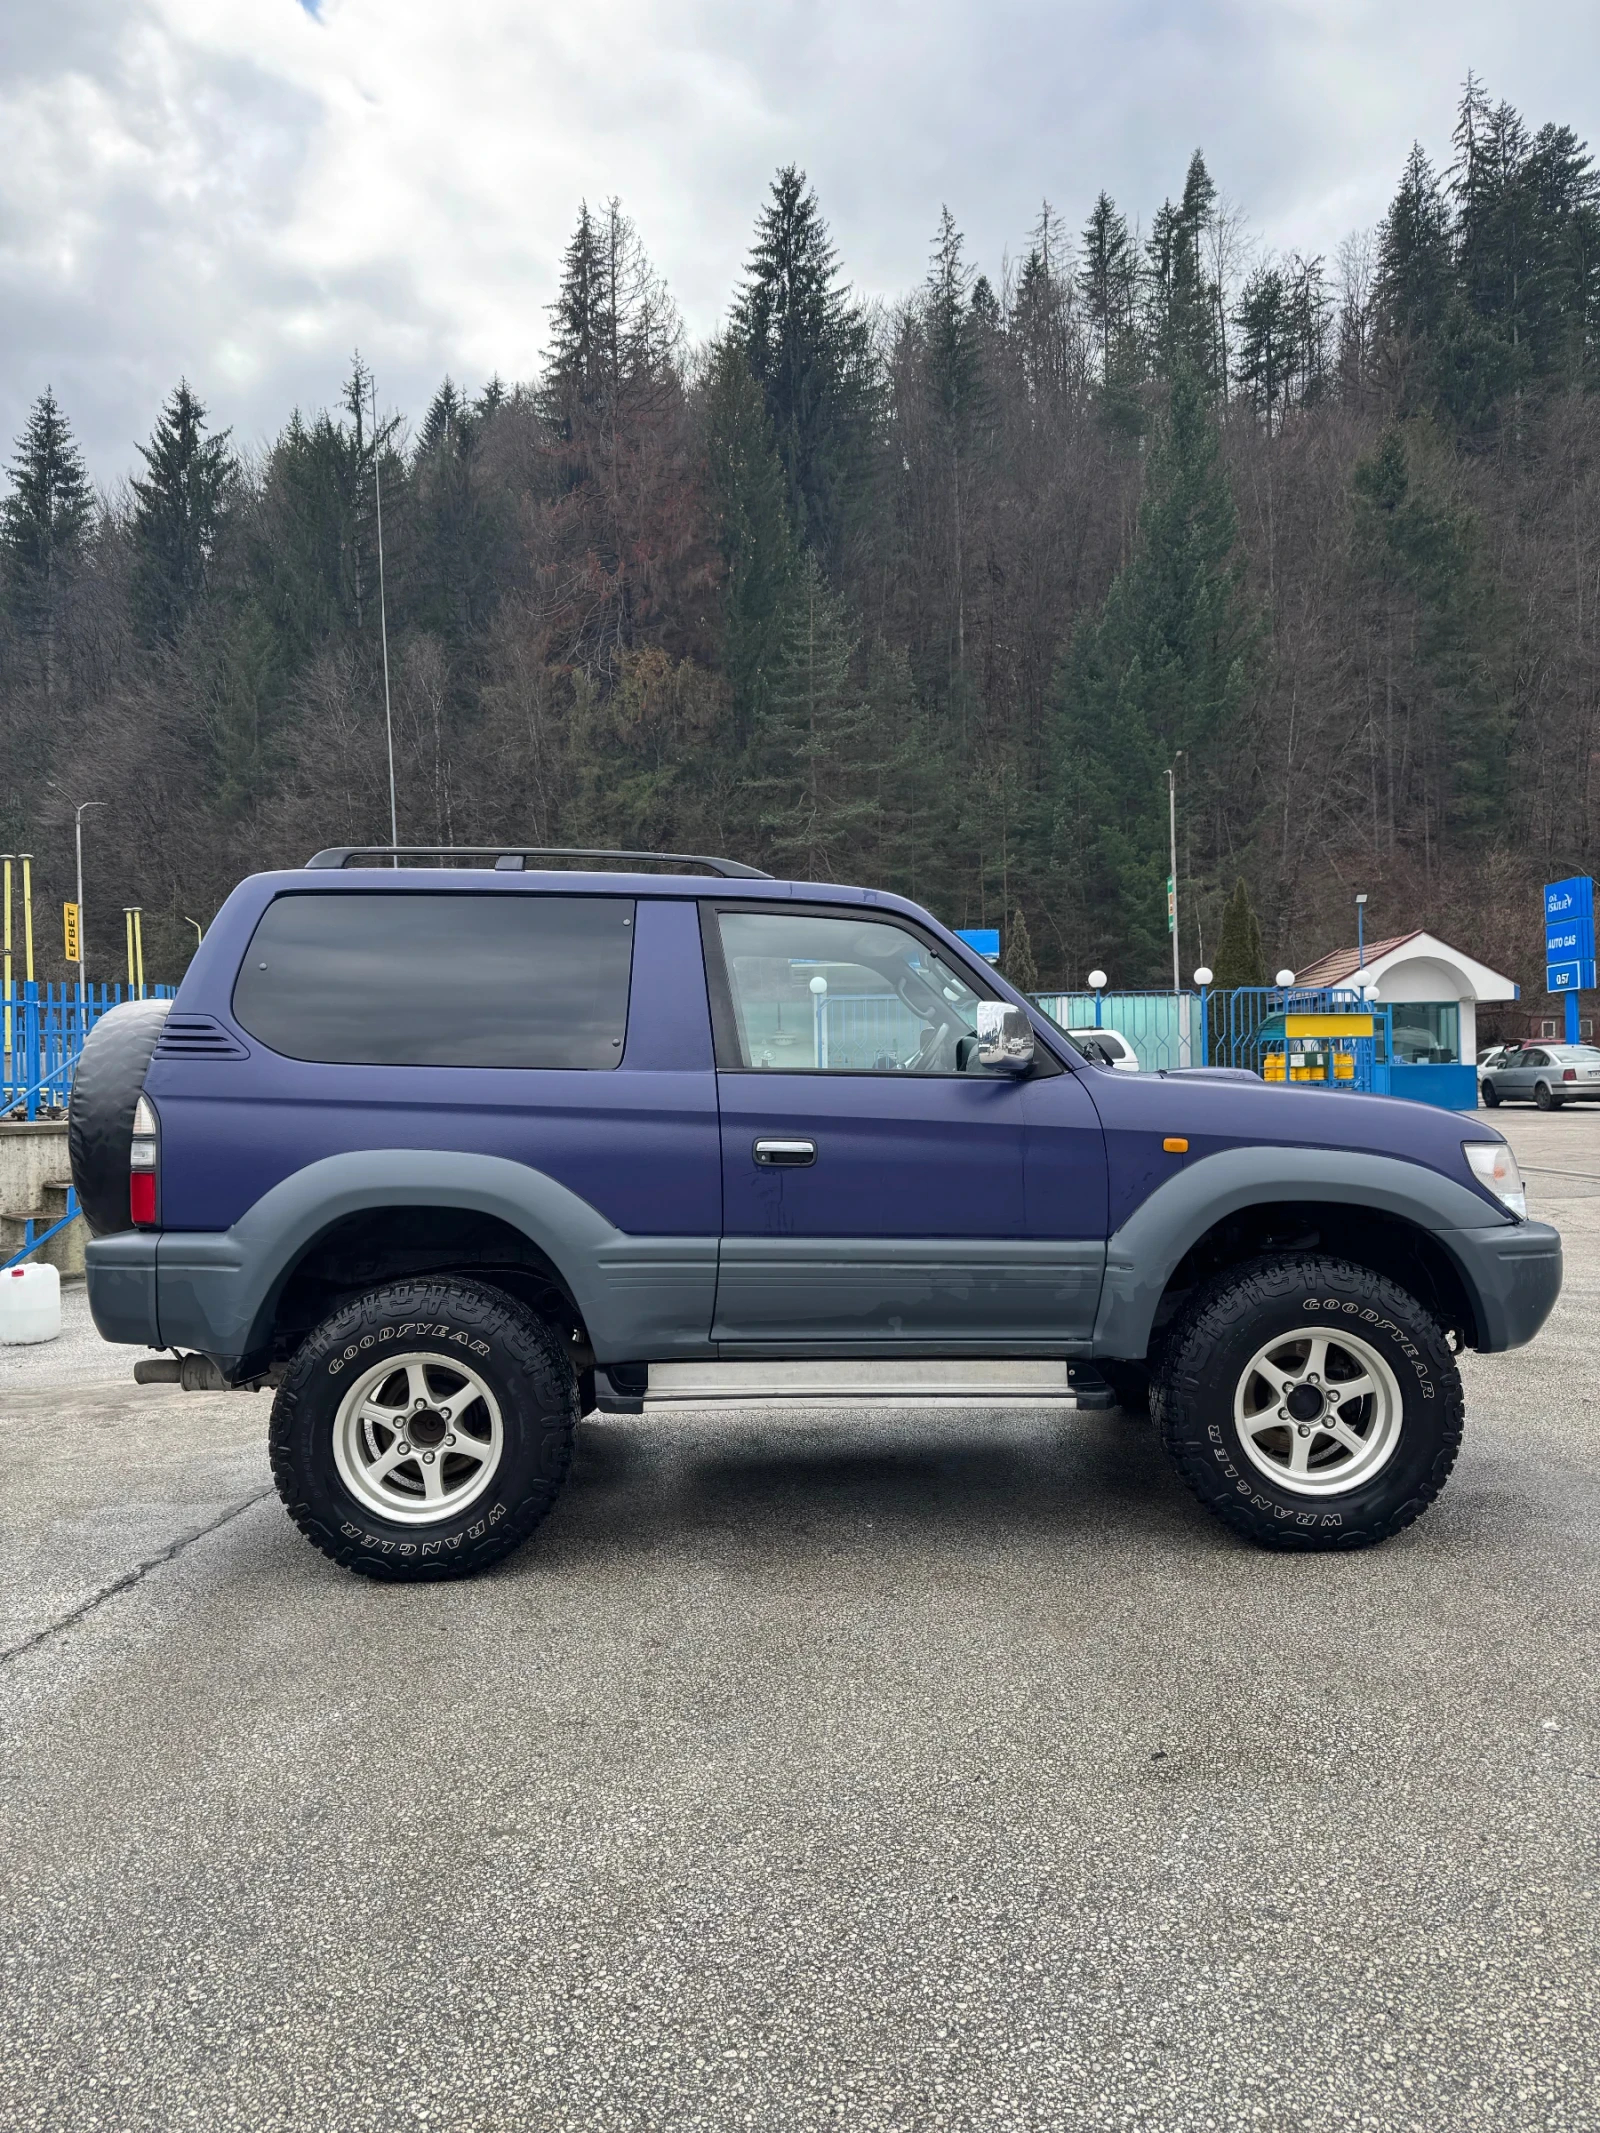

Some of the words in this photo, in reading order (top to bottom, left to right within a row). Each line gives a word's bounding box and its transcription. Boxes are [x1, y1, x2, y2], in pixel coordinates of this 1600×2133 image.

[68, 907, 76, 957] EFBET
[1548, 937, 1563, 949] AUTO
[1563, 934, 1576, 947] GAS
[328, 1322, 490, 1375] GOODYEAR
[1303, 1298, 1435, 1400] GOODYEAR
[1207, 1424, 1343, 1527] WRANGLER
[340, 1503, 507, 1556] WRANGLER
